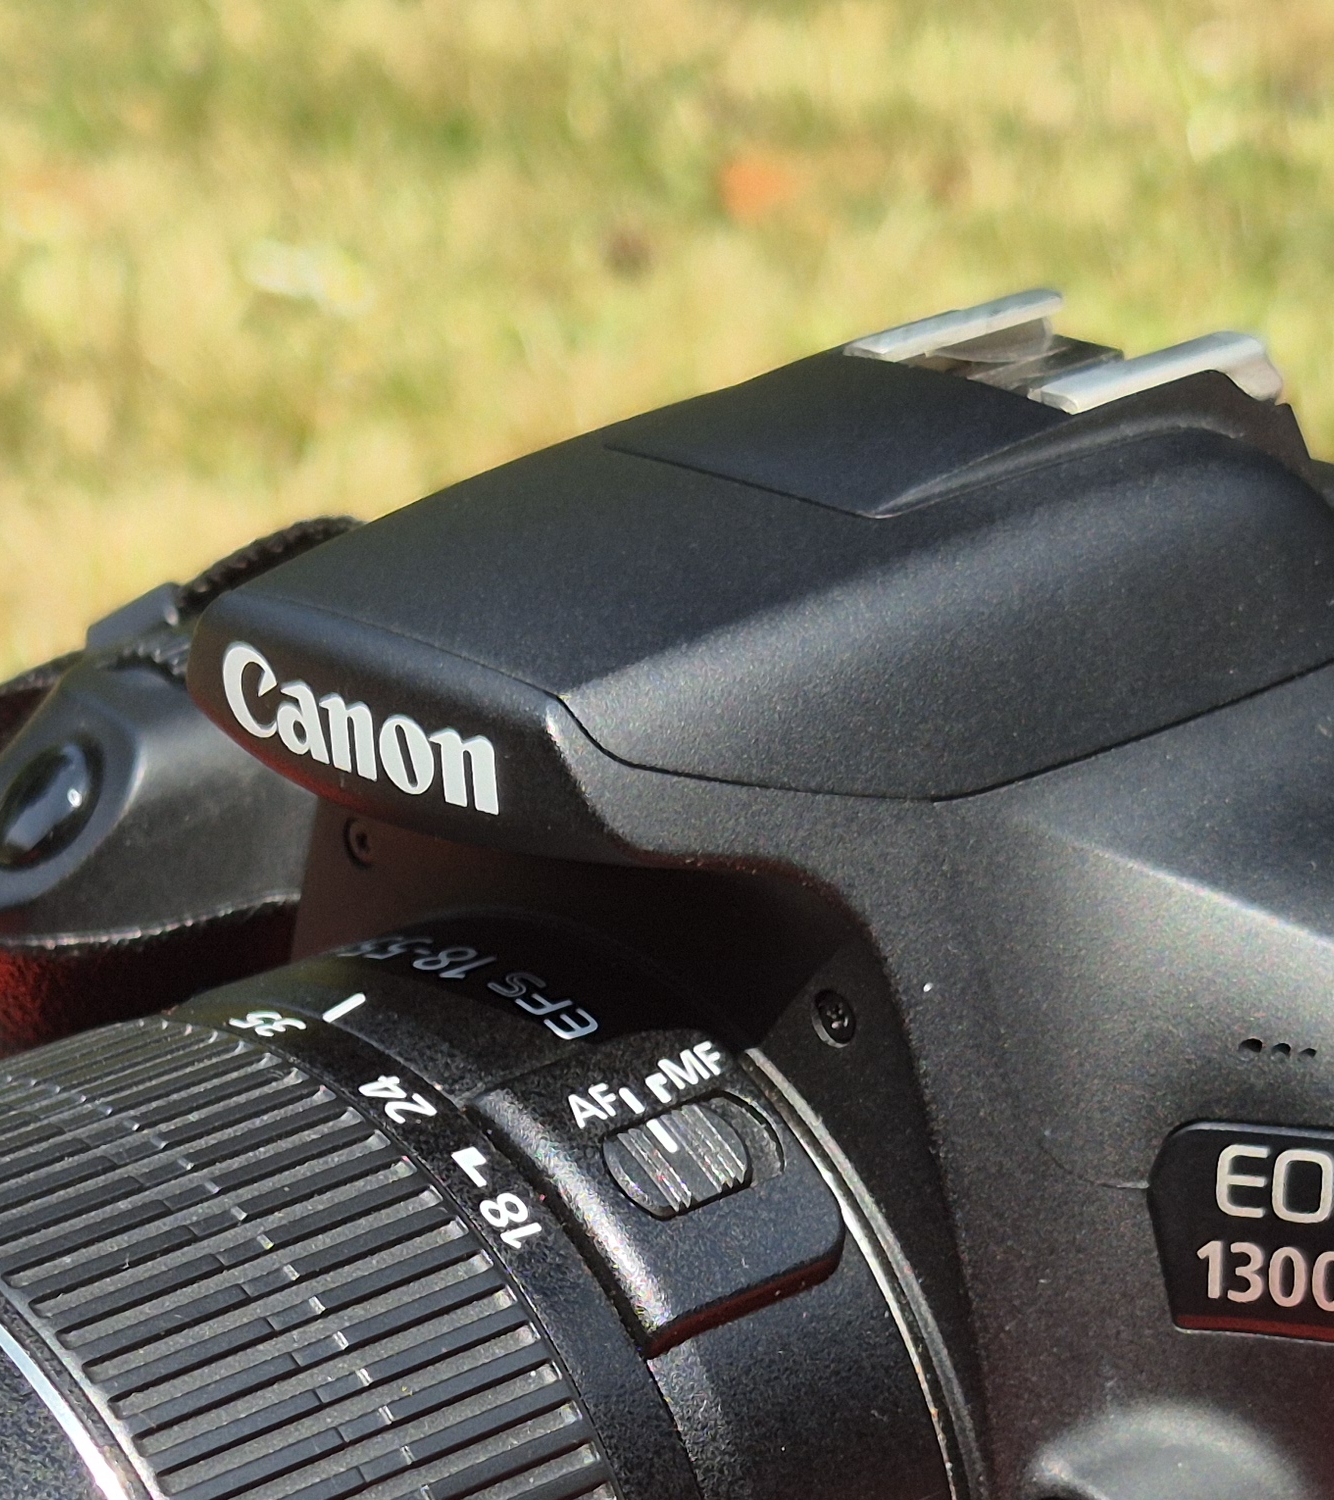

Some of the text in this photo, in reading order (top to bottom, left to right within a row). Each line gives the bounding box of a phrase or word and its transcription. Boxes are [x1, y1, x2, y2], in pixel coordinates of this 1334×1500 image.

[222, 641, 499, 815] Canon
[228, 1011, 307, 1037] 35
[358, 1075, 437, 1124] 24
[567, 1040, 721, 1130] AF MF
[479, 1192, 542, 1249] 18
